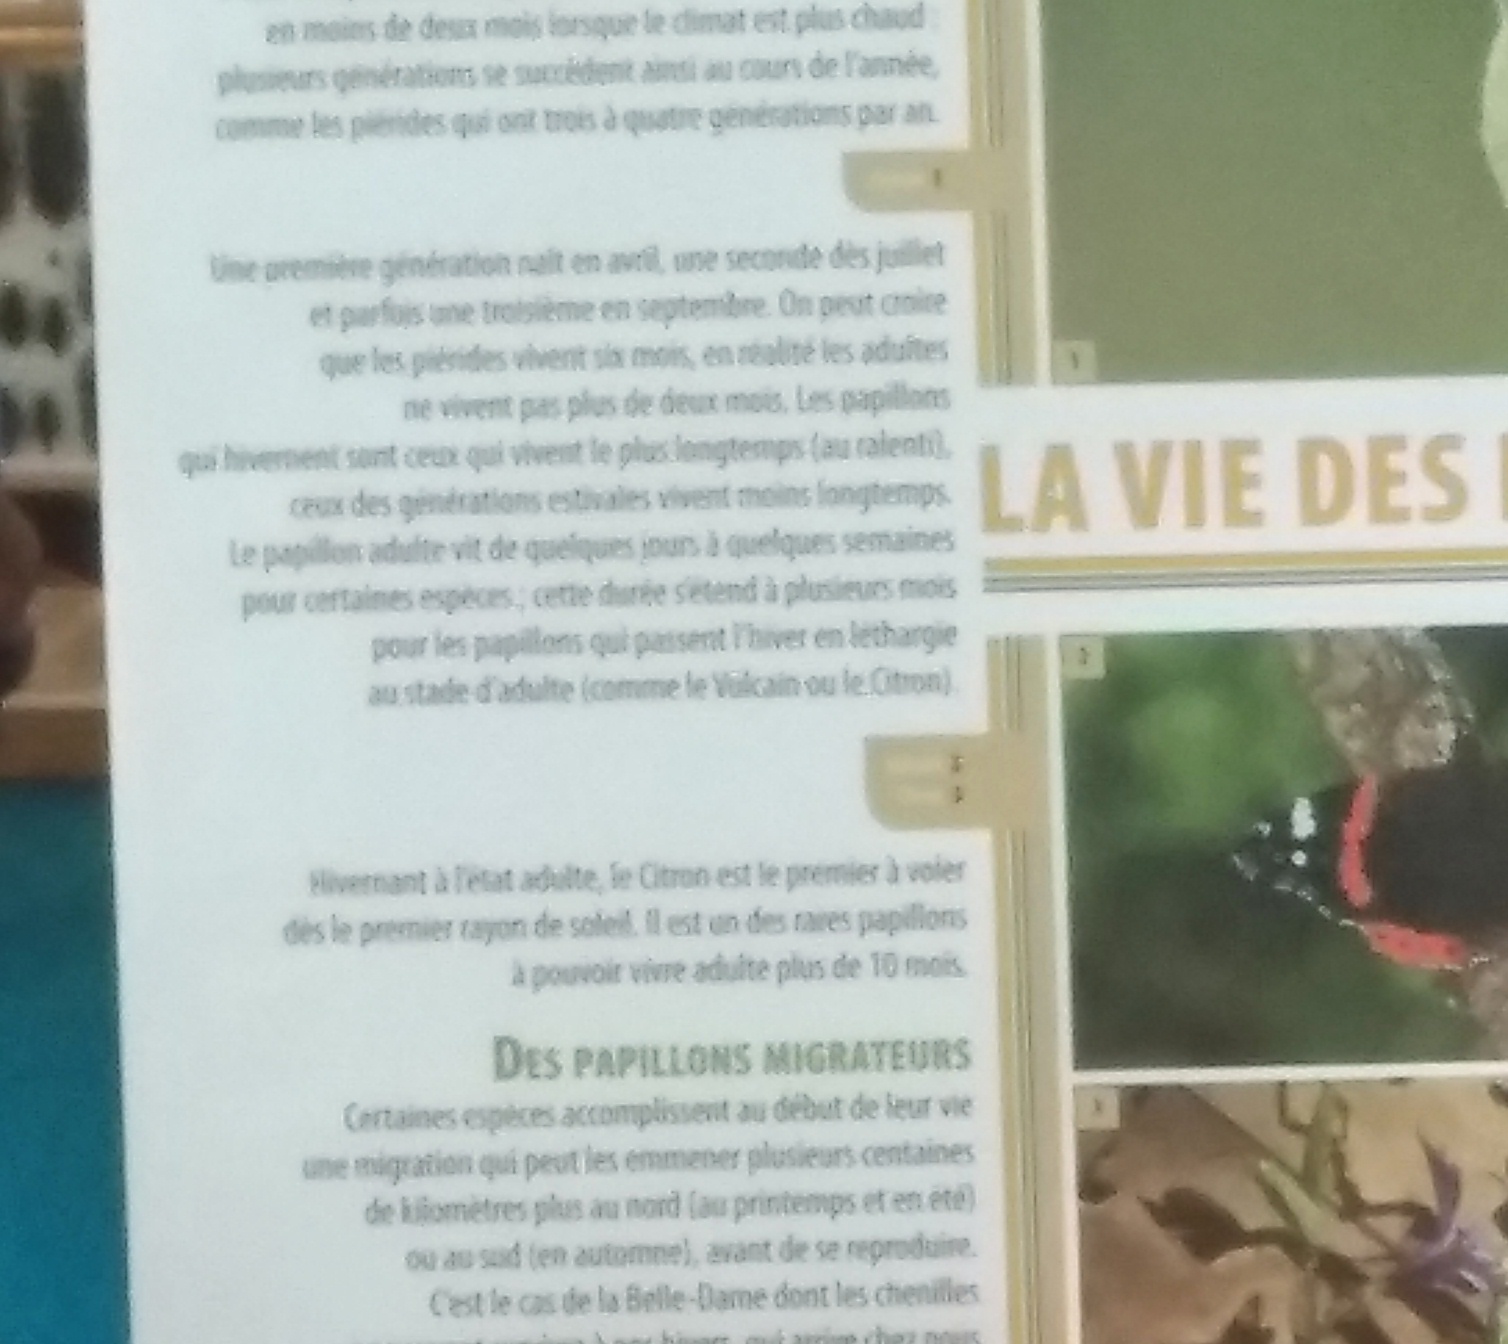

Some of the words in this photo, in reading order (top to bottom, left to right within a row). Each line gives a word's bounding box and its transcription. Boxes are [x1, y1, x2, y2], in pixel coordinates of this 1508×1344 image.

[979, 441, 1091, 535] LA
[1113, 435, 1266, 531] VIE
[1297, 430, 1469, 527] DES
[494, 1034, 562, 1080] DES
[574, 1044, 752, 1078] PAPILLONS
[765, 1036, 973, 1075] MIGRATEURS
